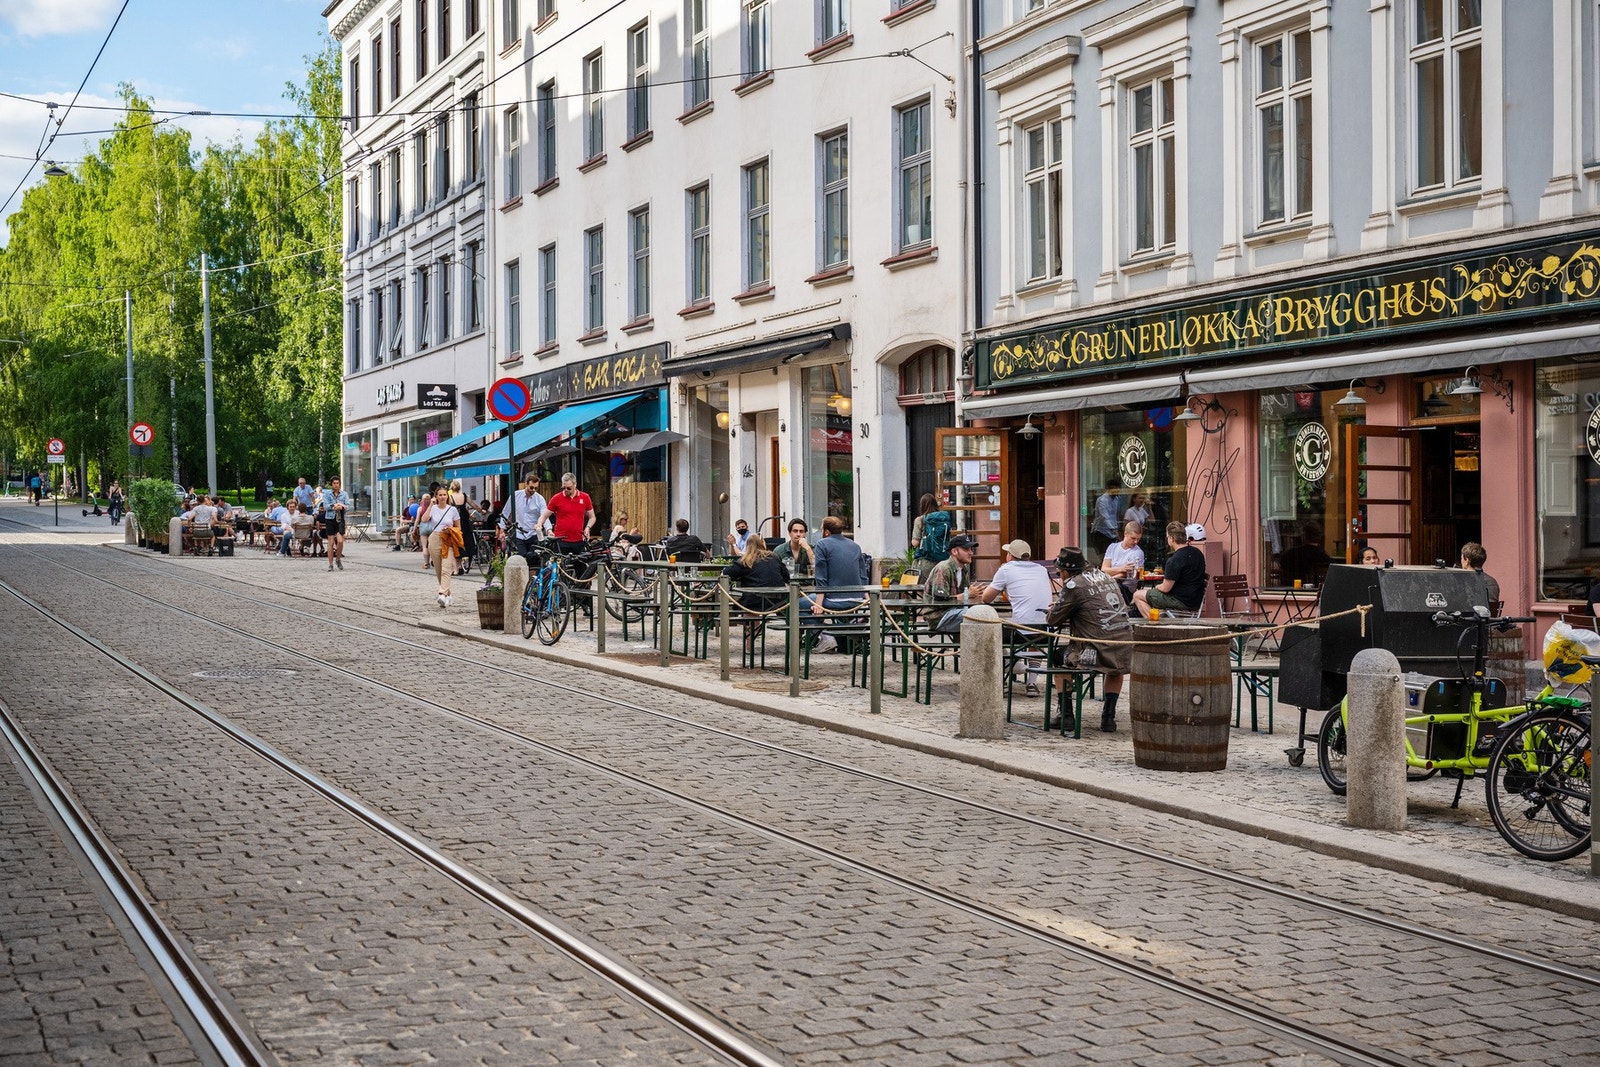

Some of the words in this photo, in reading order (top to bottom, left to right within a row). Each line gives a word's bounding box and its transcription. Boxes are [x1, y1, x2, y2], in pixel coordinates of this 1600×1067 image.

[1070, 308, 1259, 365] GRÜNERLØKKA
[1273, 276, 1447, 336] BRYGGHUS
[584, 360, 610, 392] BAR
[613, 353, 646, 387] BOCA
[860, 422, 870, 439] 30
